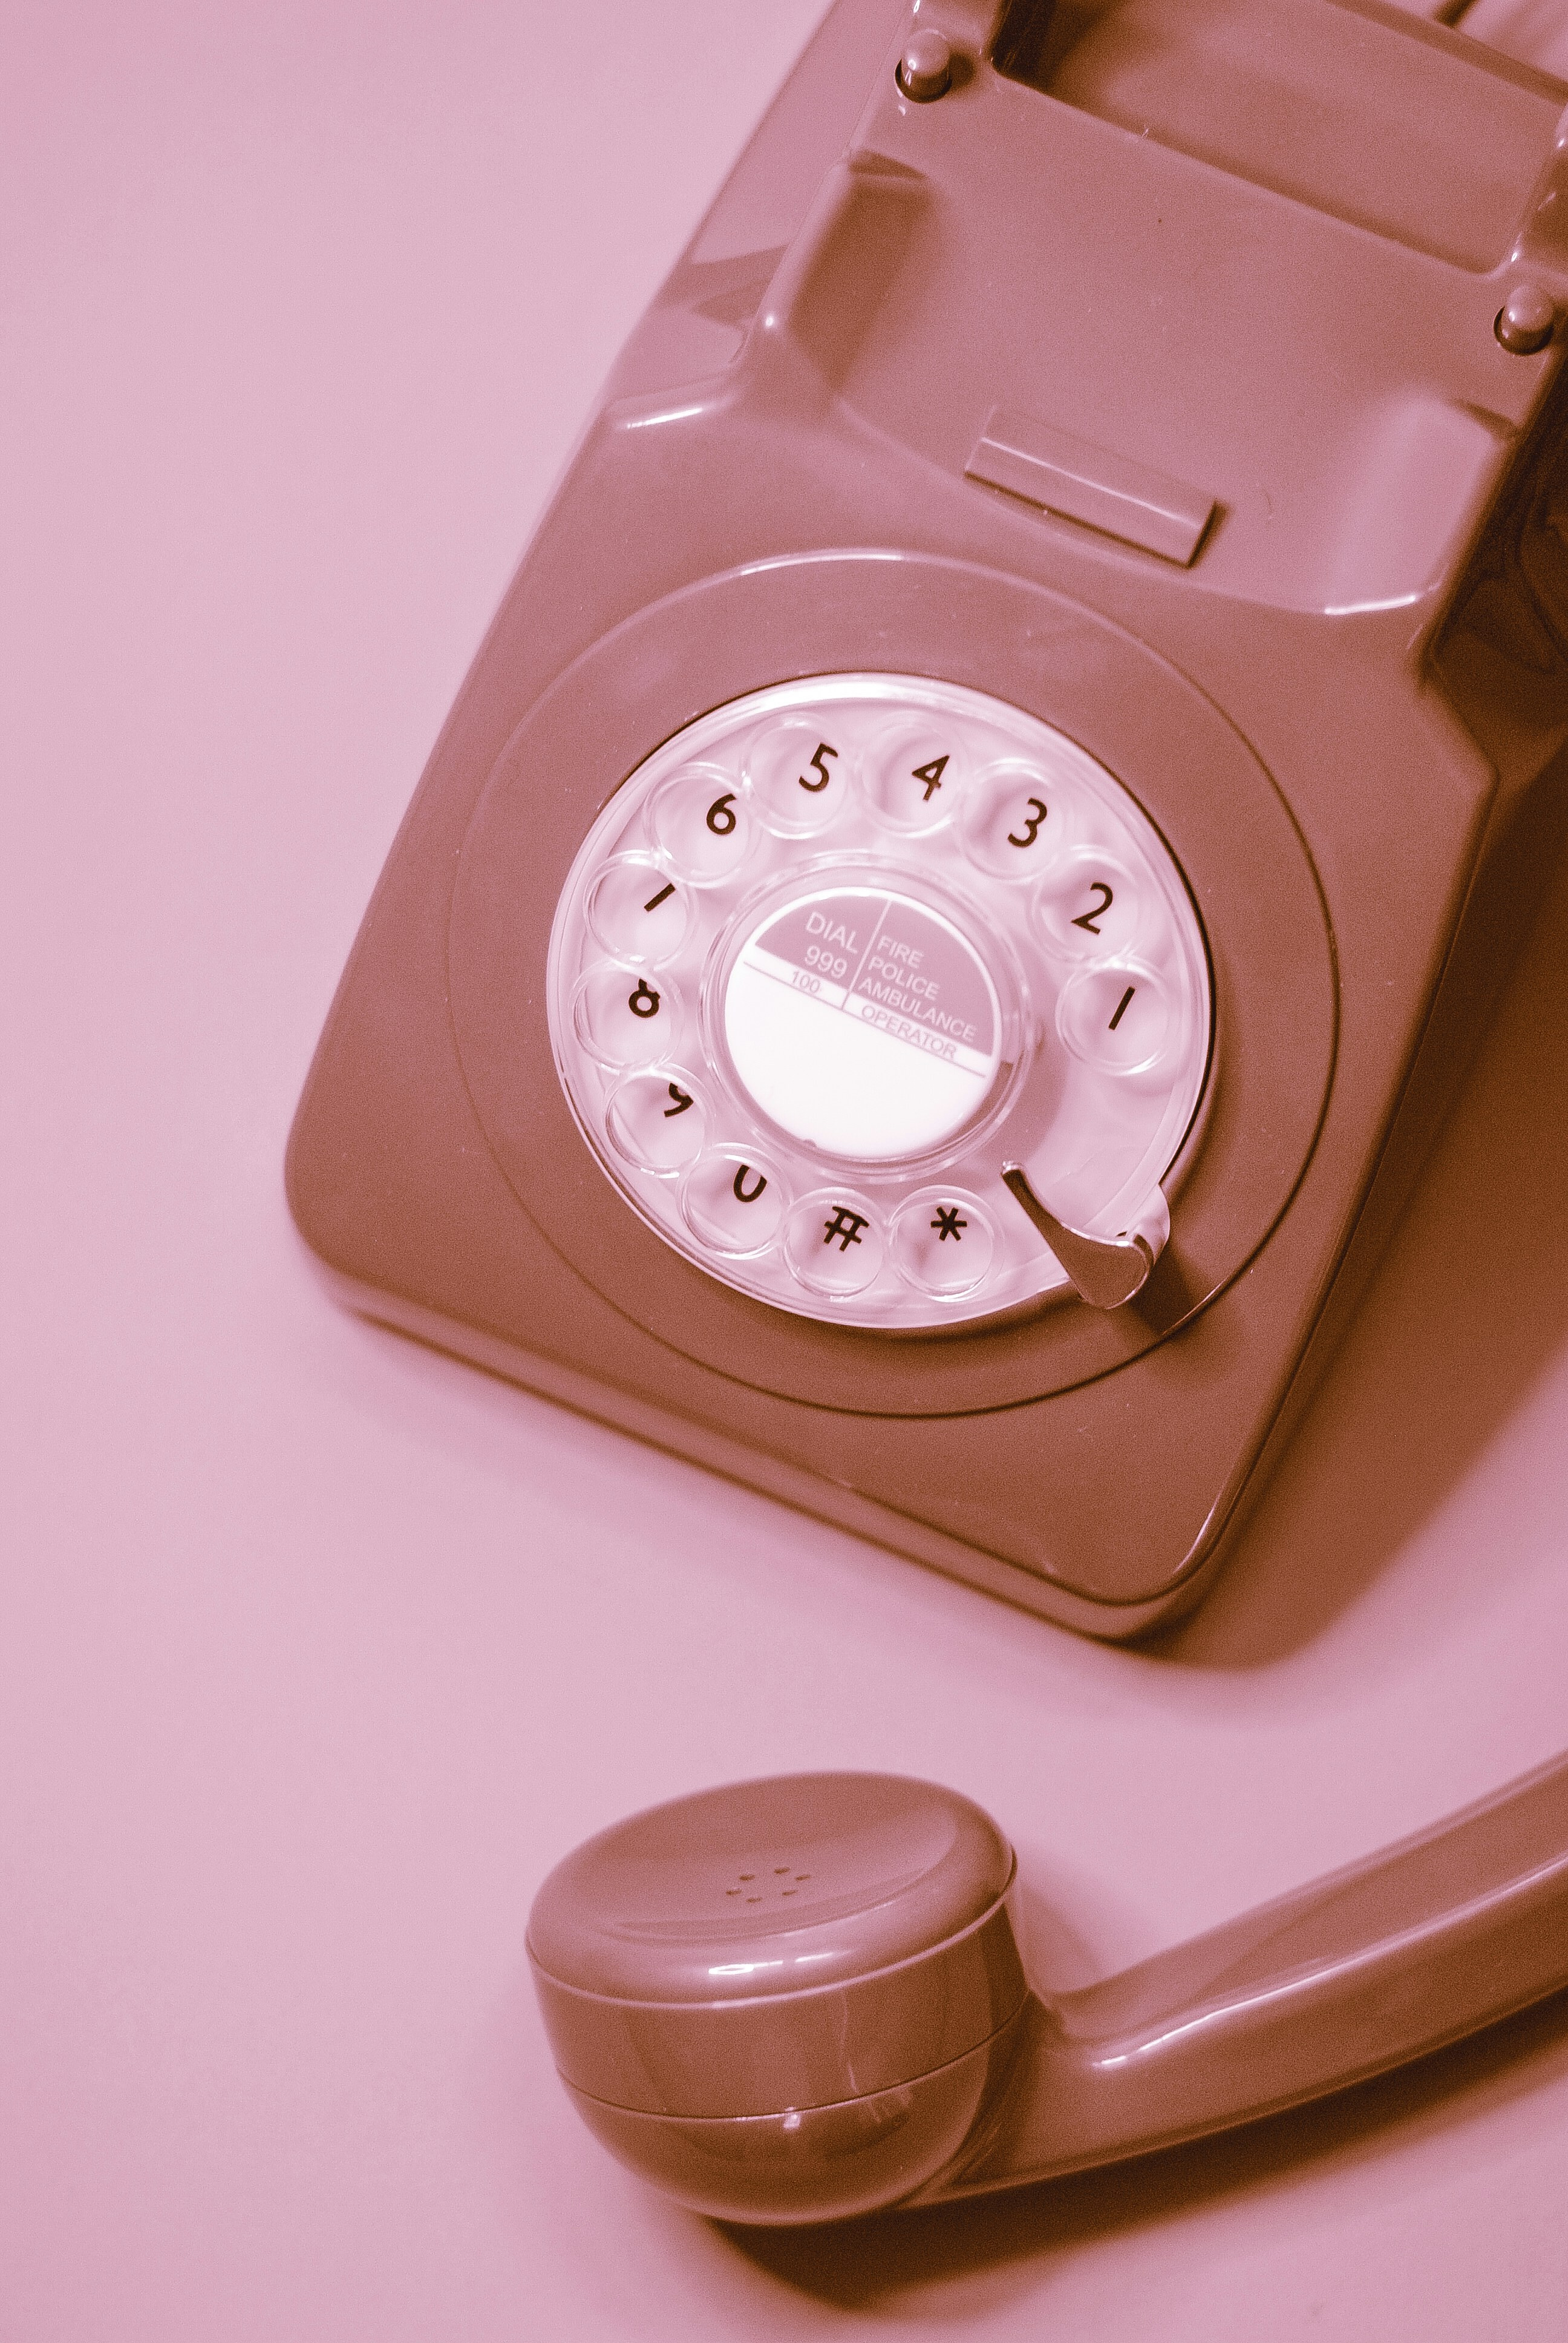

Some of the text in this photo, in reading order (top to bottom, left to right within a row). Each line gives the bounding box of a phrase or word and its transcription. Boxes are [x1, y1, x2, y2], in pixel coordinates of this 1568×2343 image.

[799, 743, 838, 792] 5
[912, 755, 950, 801] 4
[706, 793, 736, 835] 6
[1008, 798, 1047, 847] 3
[1071, 882, 1113, 934] 2
[805, 911, 858, 954] DIAL
[877, 935, 924, 968] FIRE
[791, 971, 821, 995] 100
[803, 945, 848, 980] 999
[868, 957, 939, 1000] POLICE
[858, 977, 977, 1041] AMBULANCE
[1108, 986, 1135, 1031] 1
[861, 1005, 957, 1061] OPERATOR
